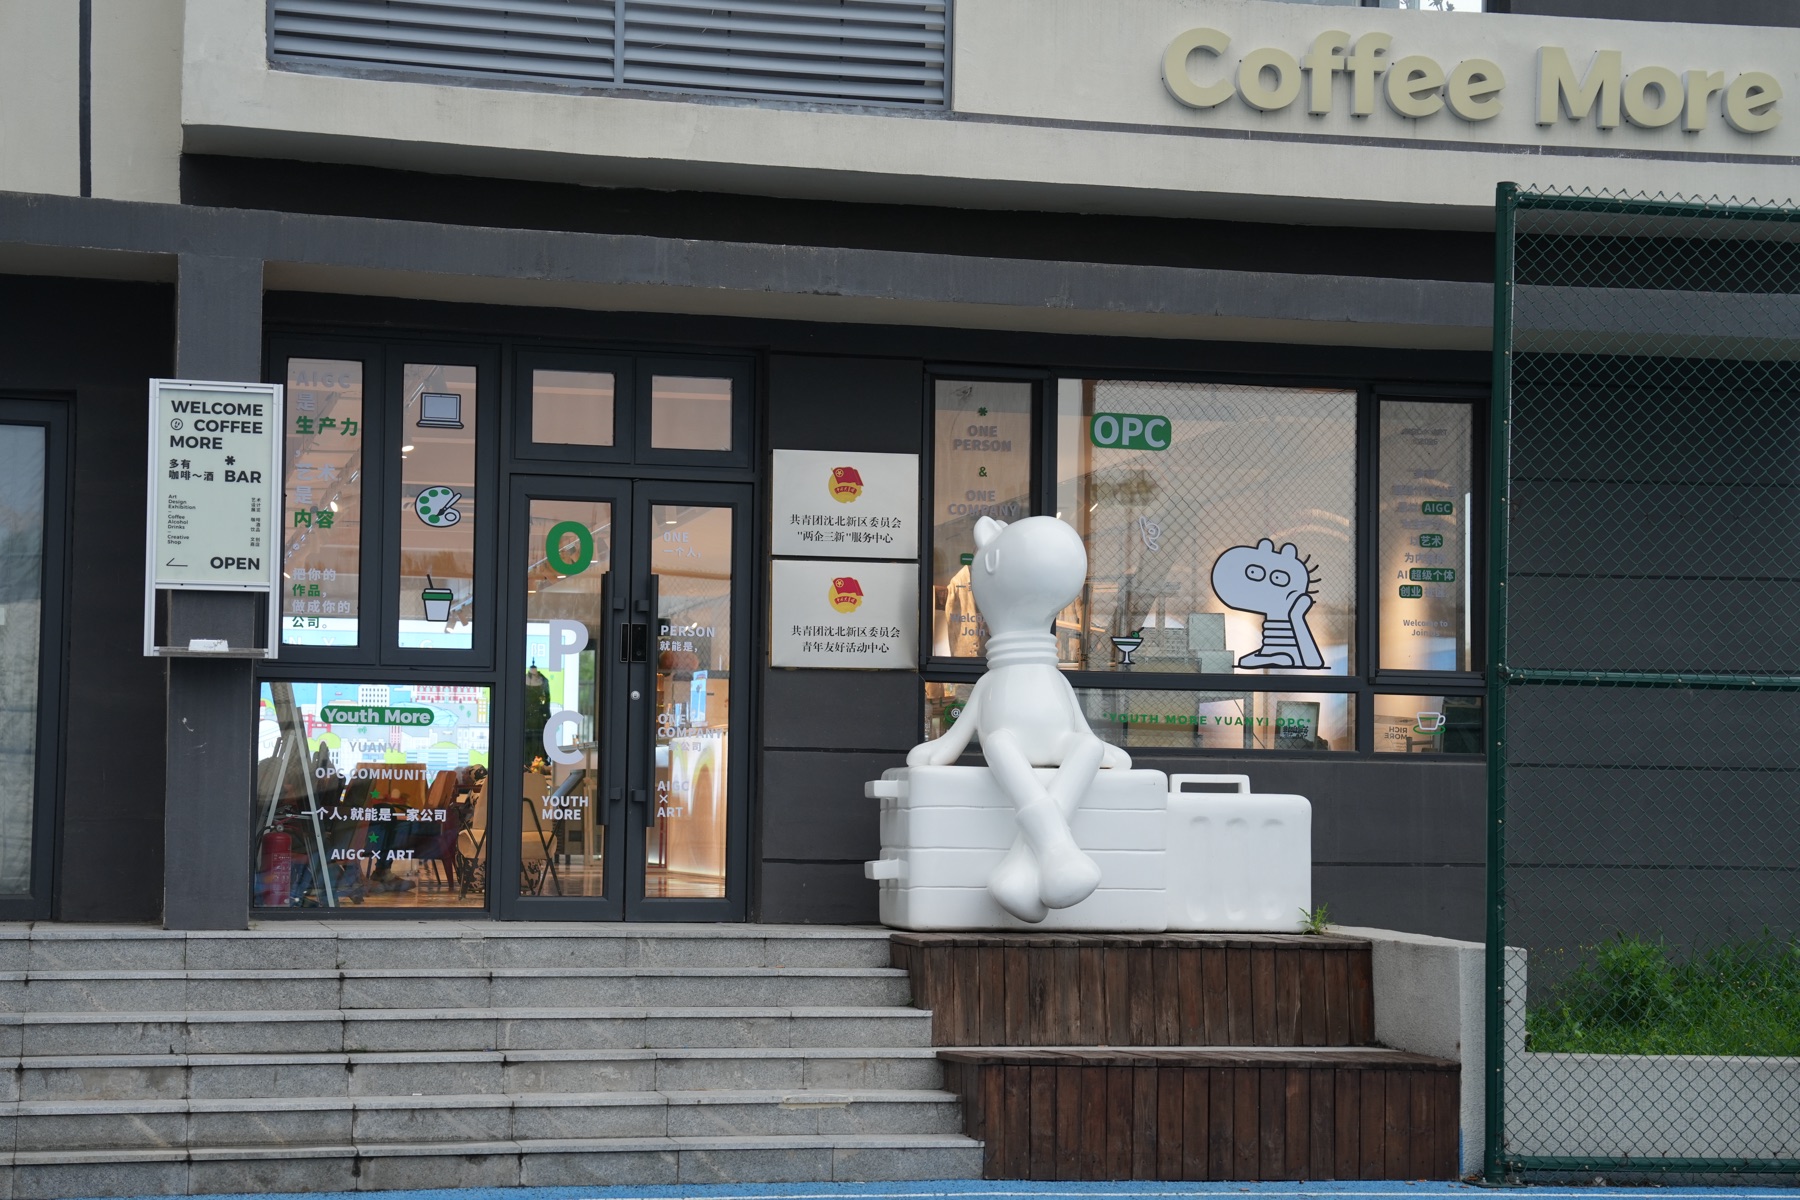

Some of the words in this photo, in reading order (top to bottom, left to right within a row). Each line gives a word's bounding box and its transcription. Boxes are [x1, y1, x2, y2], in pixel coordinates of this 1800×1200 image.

[1161, 27, 1506, 124] Coffee
[1536, 45, 1784, 135] More
[296, 371, 351, 388] AIGC
[296, 392, 315, 411] 是
[171, 400, 264, 417] WELCOME
[194, 419, 263, 434] COFFEE
[295, 416, 358, 436] 生产力
[967, 425, 998, 438] ONE
[1093, 415, 1169, 449] OPC
[170, 435, 223, 450] MORE
[953, 438, 1012, 452] PERSON
[168, 458, 191, 470] 多有
[224, 470, 262, 484] BAR
[295, 464, 336, 482] 艺术
[979, 466, 988, 478] &
[295, 486, 313, 504] 是
[966, 489, 996, 502] ONE
[948, 502, 1019, 517] COMPANY
[1424, 502, 1451, 513] AIGC
[294, 509, 335, 528] 内容
[790, 513, 902, 529] 共青团沈北新区委员会
[663, 531, 689, 543] ONE
[210, 557, 261, 571] OPEN
[292, 568, 336, 581] 把你的
[292, 600, 350, 613] 做成你的
[1403, 619, 1438, 627] Welcome
[660, 625, 716, 637] PERSON
[791, 625, 901, 638] 共青团沈北新区委员会
[961, 626, 985, 637] Join
[1411, 629, 1427, 637] Join
[802, 641, 890, 654] 青年友好活动中心
[324, 708, 380, 723] Youth
[385, 710, 431, 724] More
[658, 713, 686, 725] ONE
[1166, 715, 1208, 725] MORE
[1214, 716, 1270, 727] YUANYI
[657, 727, 723, 739] COMPANY
[349, 741, 401, 753] YUANYI
[315, 767, 346, 779] OPC
[349, 768, 437, 781] COMMUNITY
[657, 780, 690, 792] AIGC
[541, 795, 589, 808] YOUTH
[541, 808, 582, 820] MORE
[657, 807, 683, 818] ART
[331, 849, 366, 861] AIGC
[386, 849, 415, 861] ART
